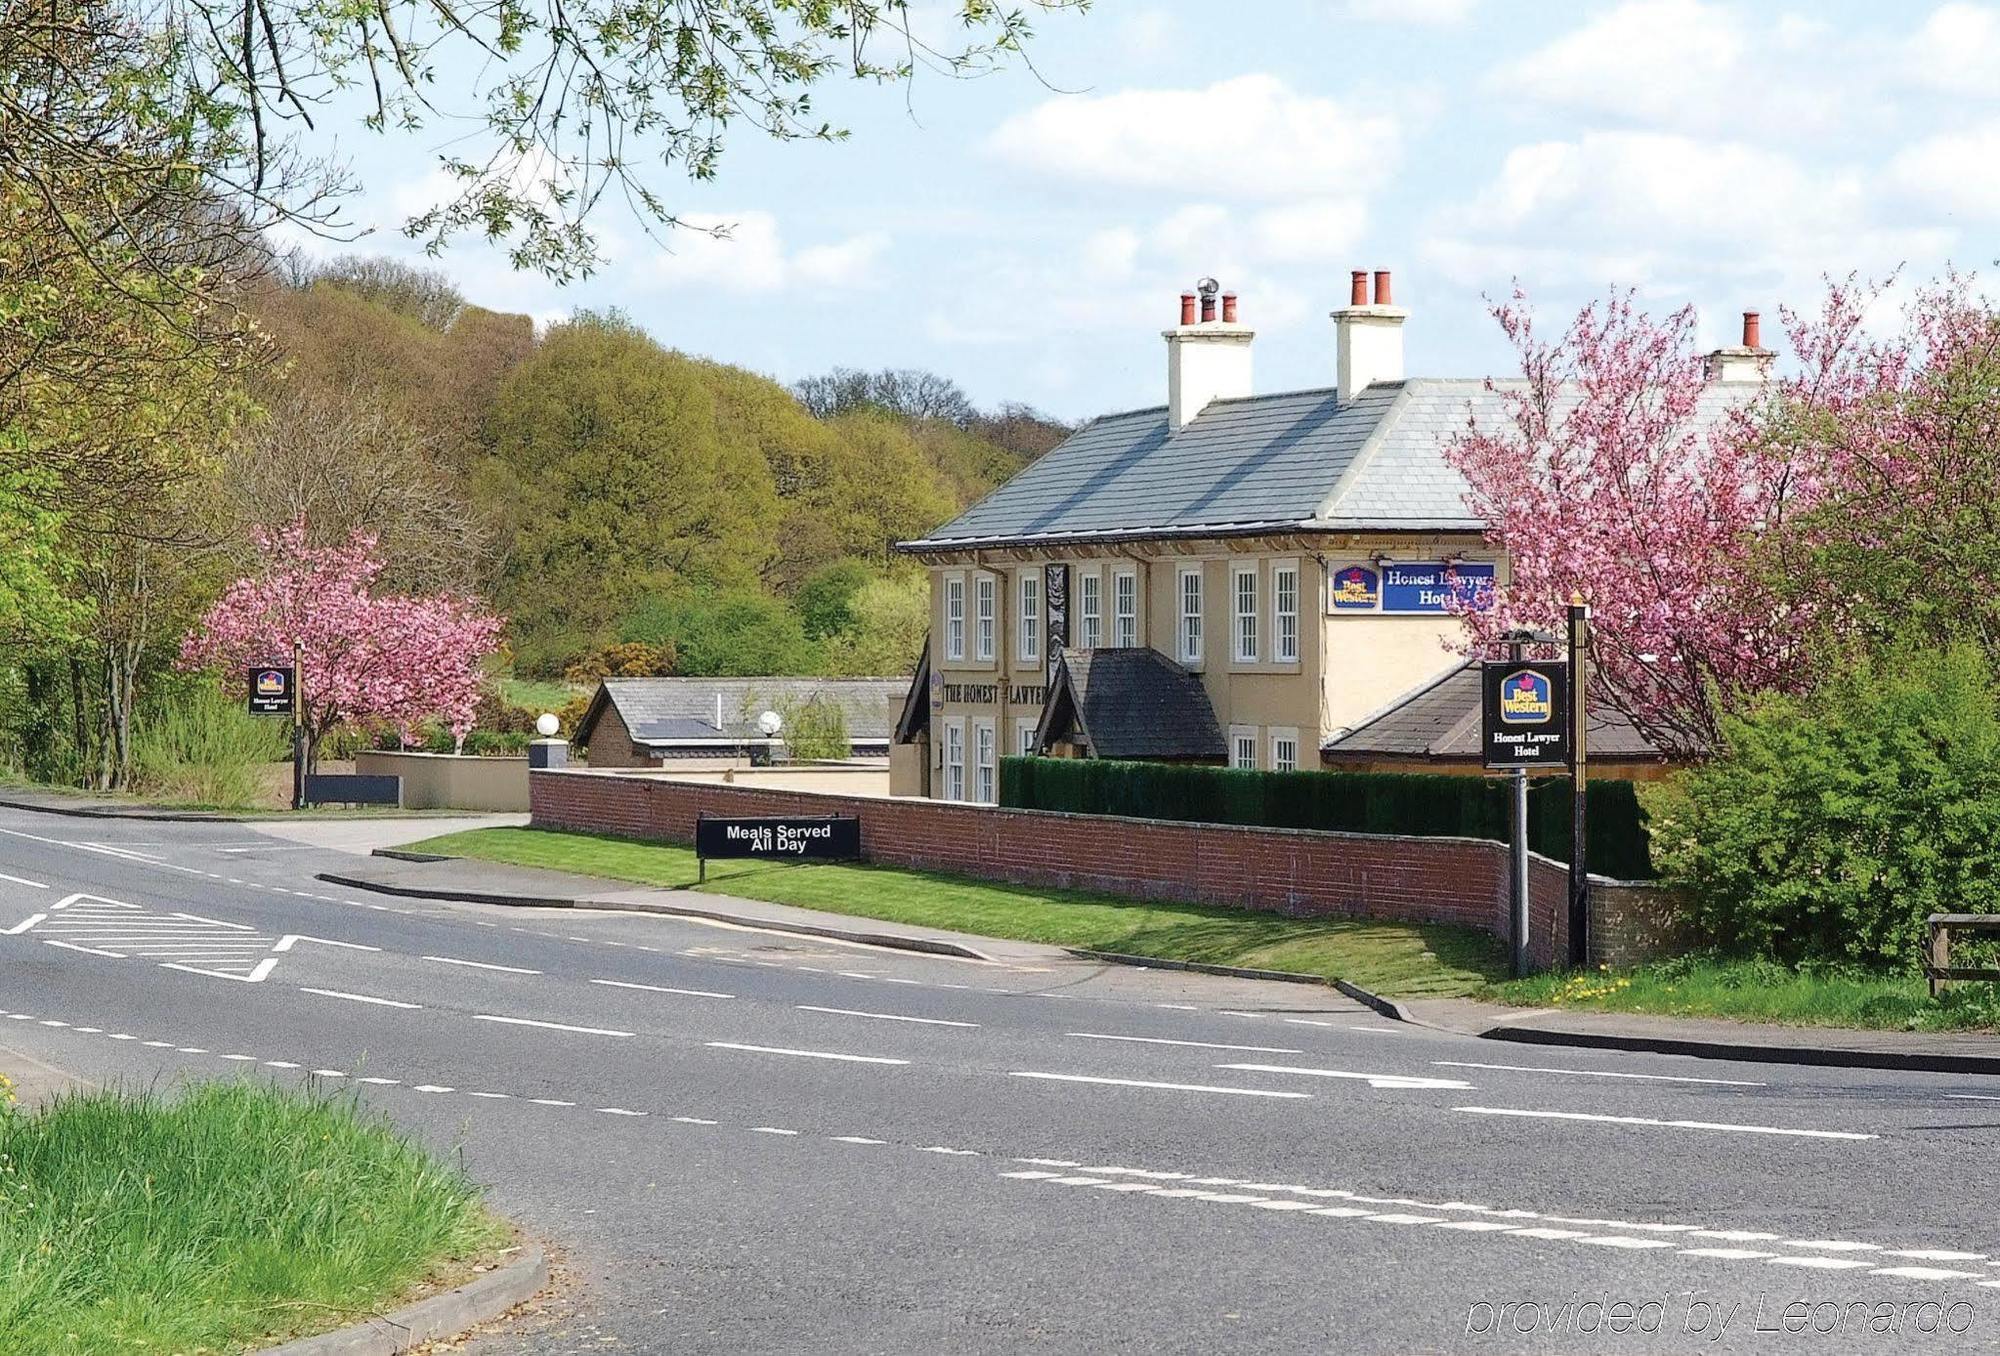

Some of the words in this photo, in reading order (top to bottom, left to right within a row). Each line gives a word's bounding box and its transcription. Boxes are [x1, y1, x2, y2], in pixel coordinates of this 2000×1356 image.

[1388, 571, 1434, 585] Honest
[944, 684, 961, 702] THE
[963, 684, 998, 704] HONEST
[1513, 688, 1538, 701] Best
[1504, 699, 1548, 713] Western
[1493, 732, 1525, 743] Honest
[1527, 732, 1560, 745] Lawyer
[1514, 746, 1540, 757] Hotel
[727, 825, 772, 839] Meals
[777, 824, 831, 838] Served
[751, 838, 772, 851] All
[777, 838, 807, 854] Day
